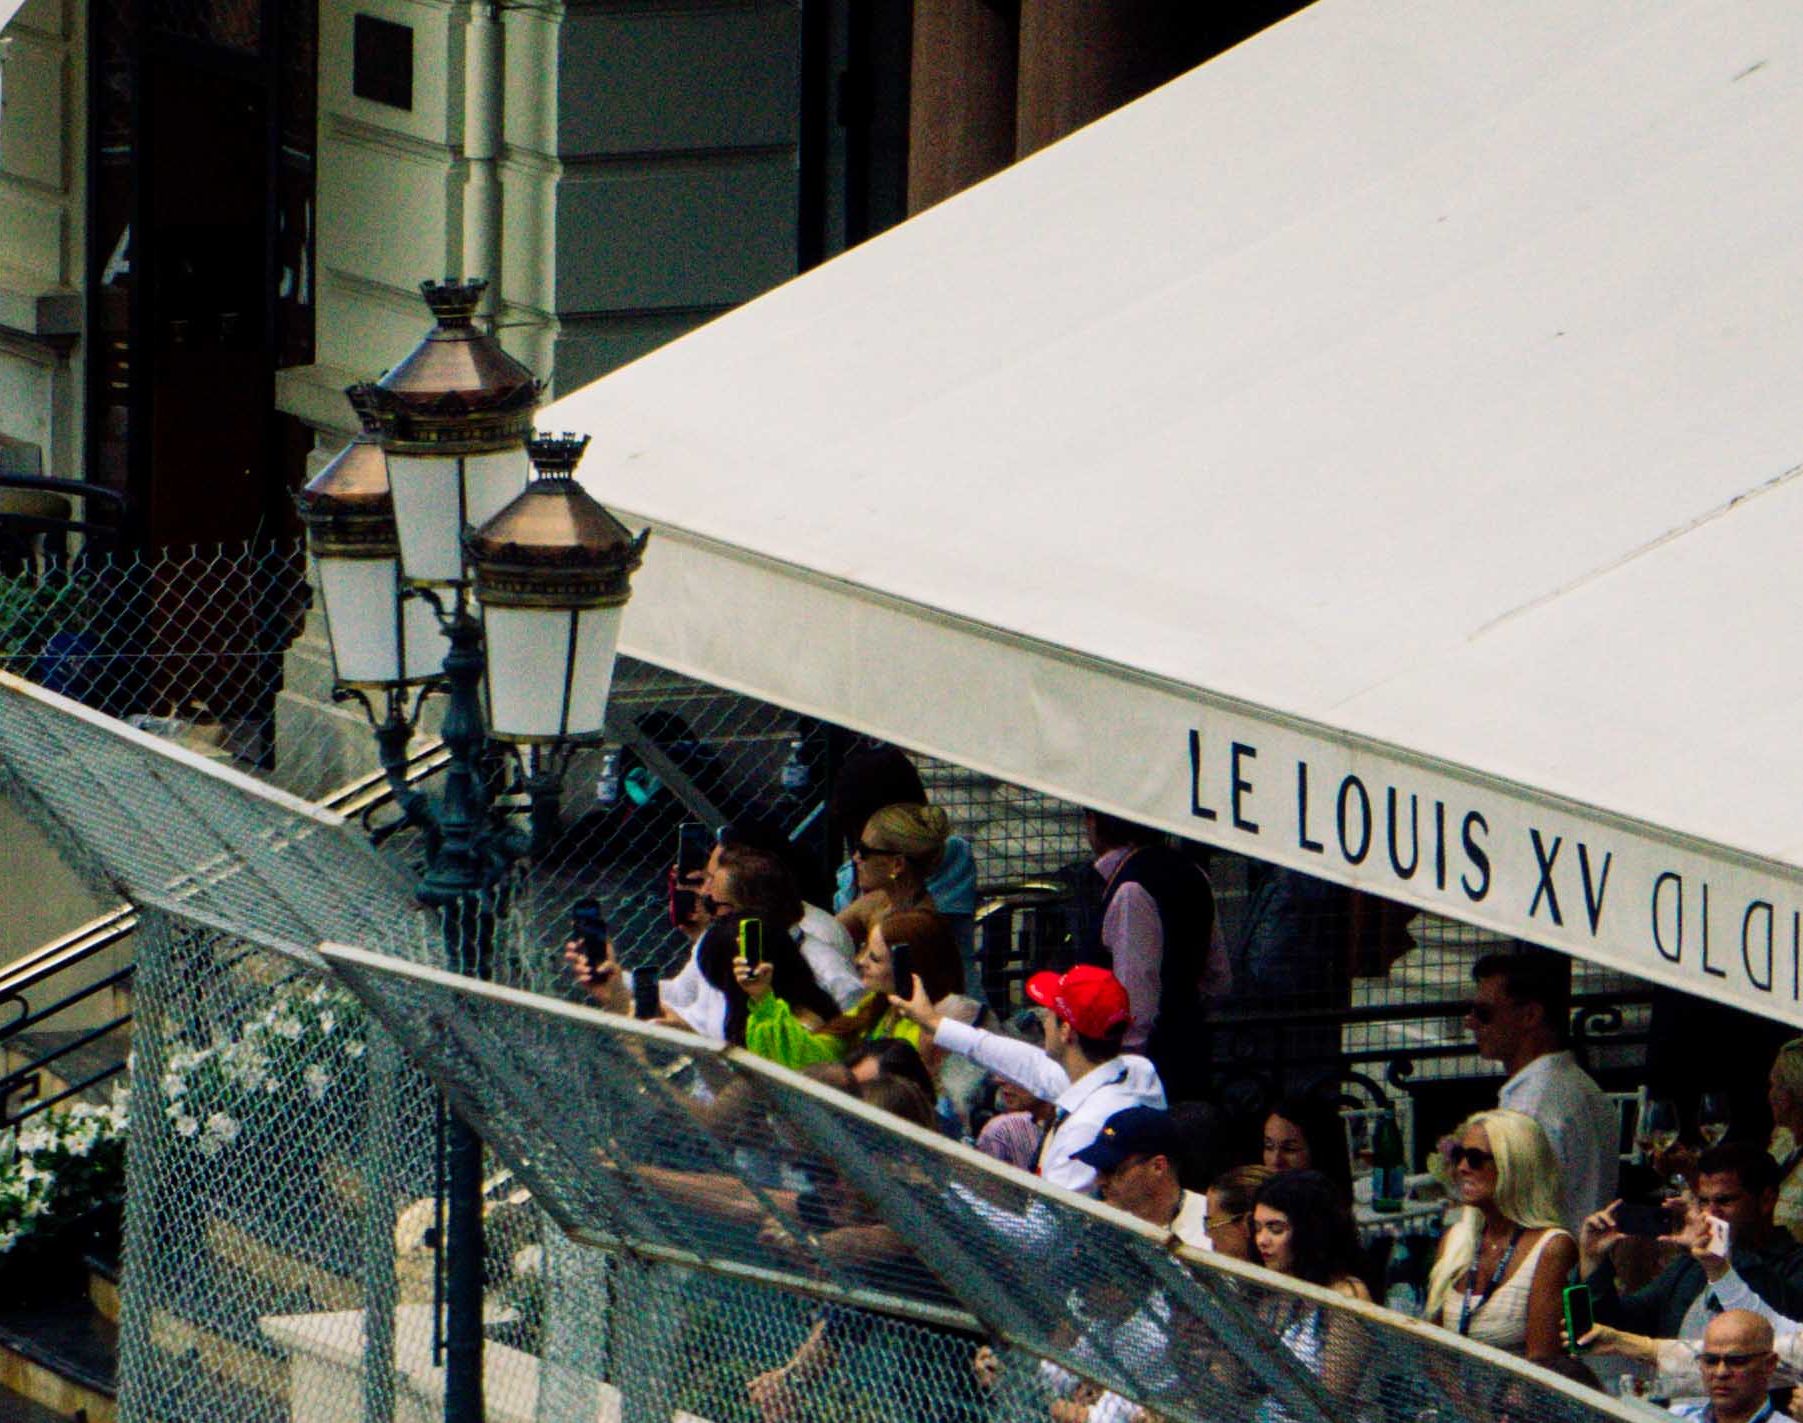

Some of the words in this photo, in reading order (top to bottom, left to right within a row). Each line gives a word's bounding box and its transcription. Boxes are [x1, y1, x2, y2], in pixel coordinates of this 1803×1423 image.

[1188, 728, 1260, 835] LE
[1298, 761, 1493, 903] LOUIS
[1528, 827, 1613, 938] XV
